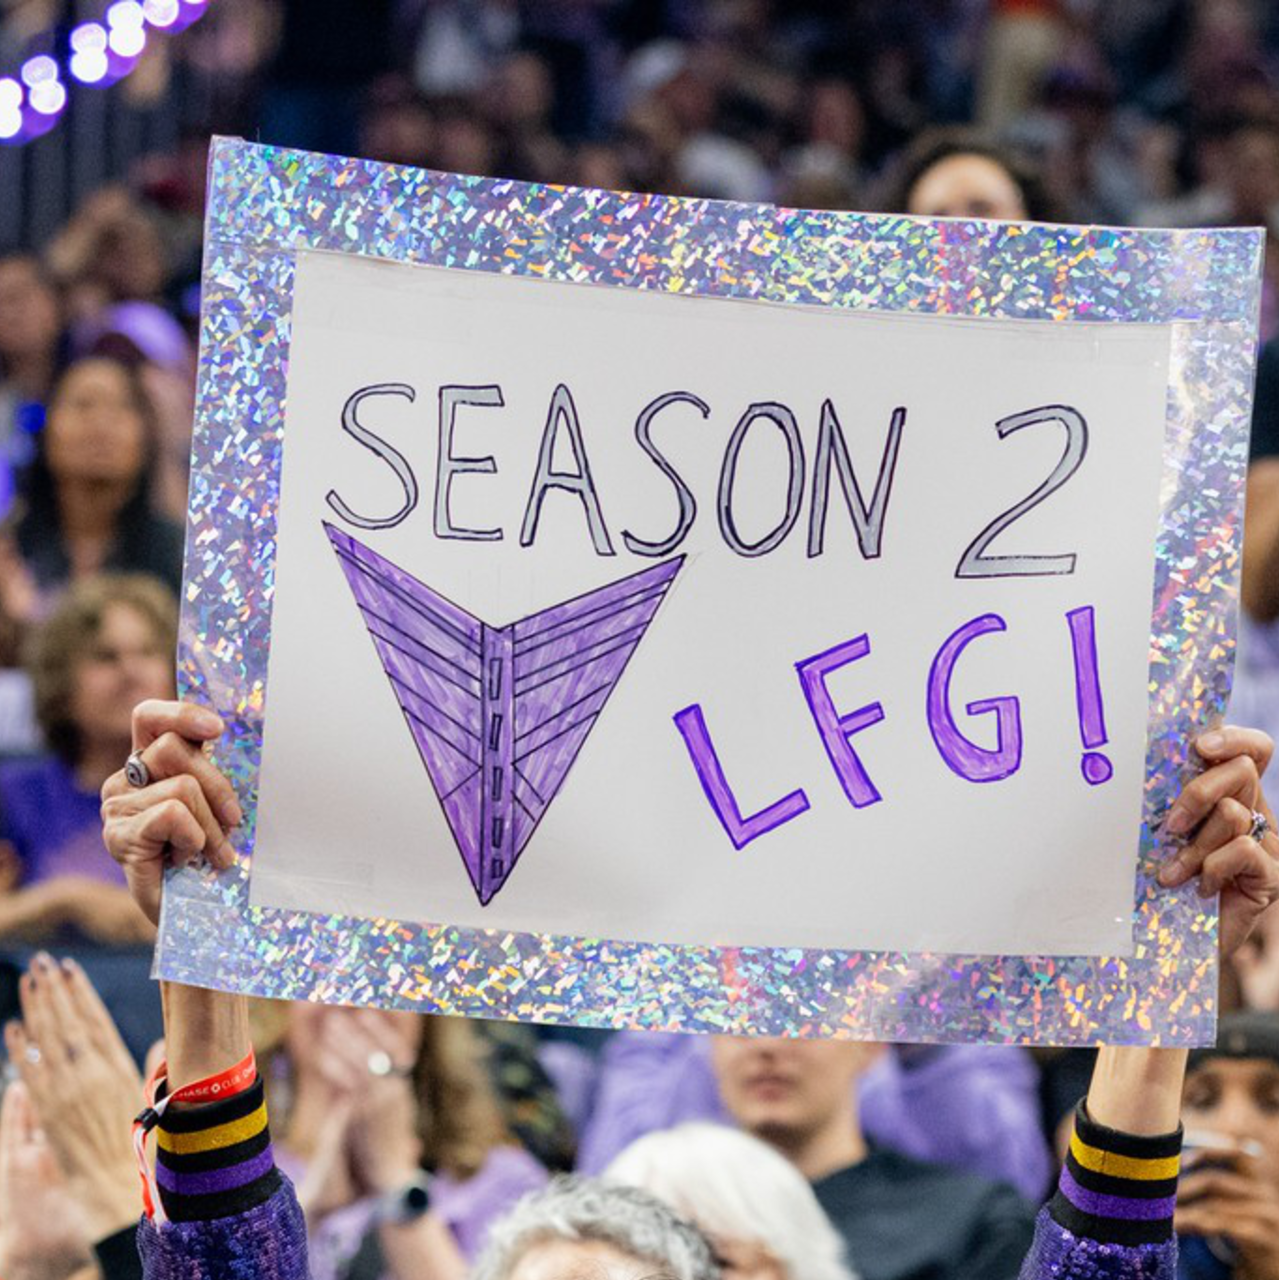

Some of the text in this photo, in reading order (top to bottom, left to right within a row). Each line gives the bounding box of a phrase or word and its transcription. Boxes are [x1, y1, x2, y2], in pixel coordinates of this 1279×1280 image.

[324, 383, 1089, 578] SEASON 2
[672, 605, 1114, 851] LFG!
